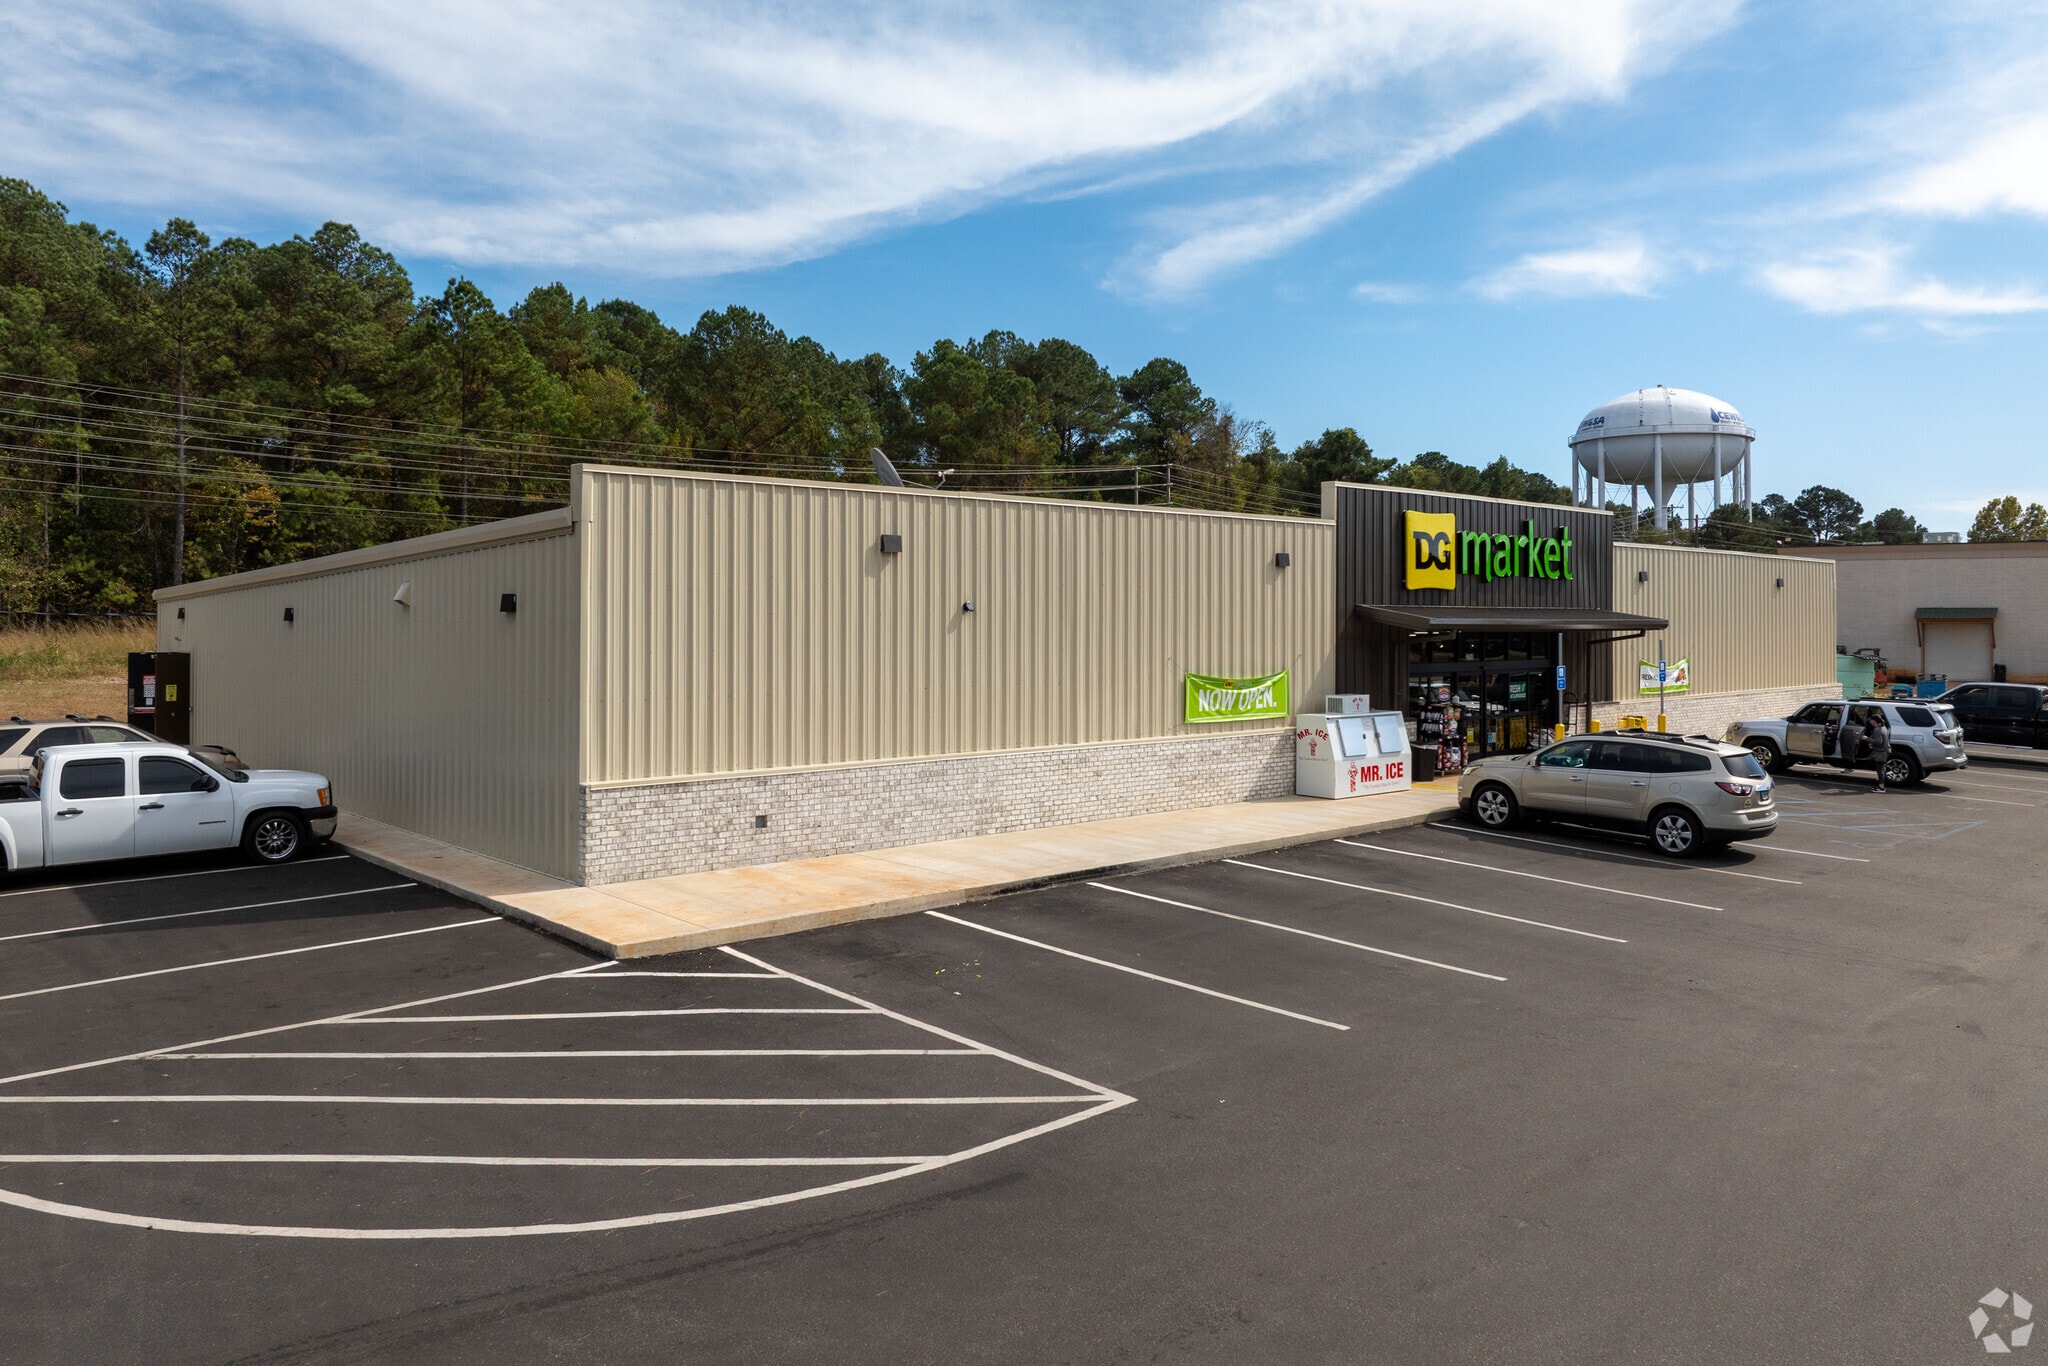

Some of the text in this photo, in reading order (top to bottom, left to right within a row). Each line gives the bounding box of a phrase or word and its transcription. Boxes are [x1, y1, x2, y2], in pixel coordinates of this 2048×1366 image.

[1413, 519, 1574, 583] DG market
[1198, 687, 1277, 712] NOW OPEN.
[1296, 728, 1329, 741] MR. ICE
[1360, 762, 1404, 783] MR. ICE
